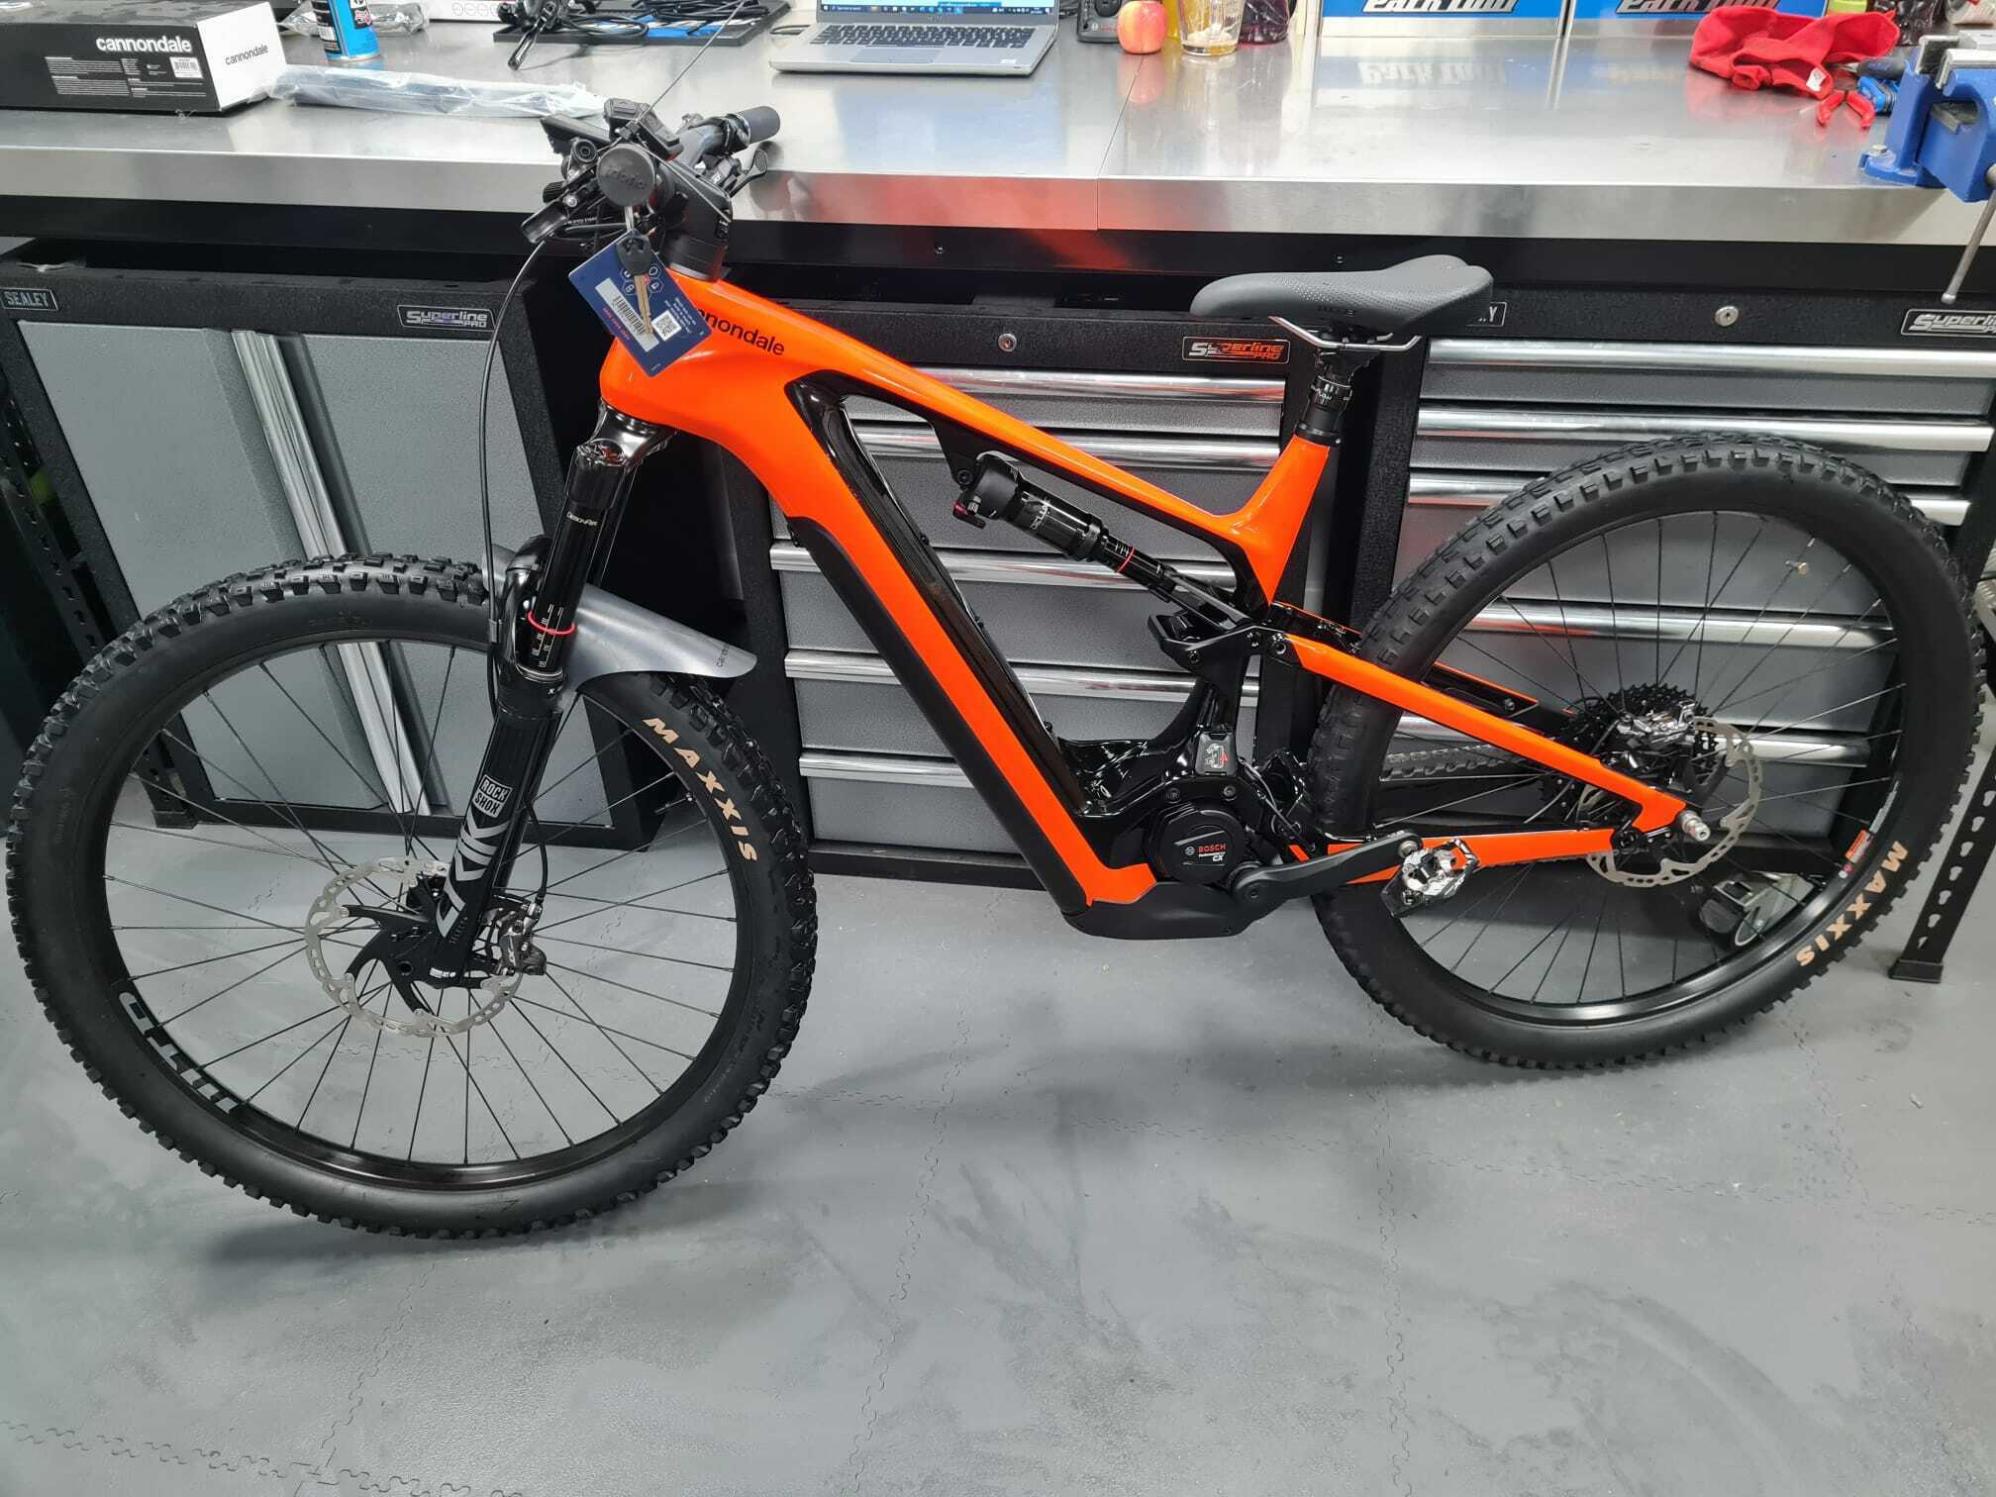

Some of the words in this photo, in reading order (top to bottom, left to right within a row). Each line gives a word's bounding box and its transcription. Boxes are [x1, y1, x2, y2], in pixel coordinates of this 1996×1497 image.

[95, 35, 192, 53] cannondale
[225, 43, 269, 66] cannondale
[4, 291, 49, 307] SEALEY
[406, 310, 488, 325] Superline
[464, 320, 487, 328] PRO
[480, 777, 512, 802] ROCK
[642, 717, 758, 861] MAXXIS
[473, 791, 501, 817] SHOX
[1198, 843, 1226, 853] BOSCH
[1796, 840, 1908, 966] MAXXIS
